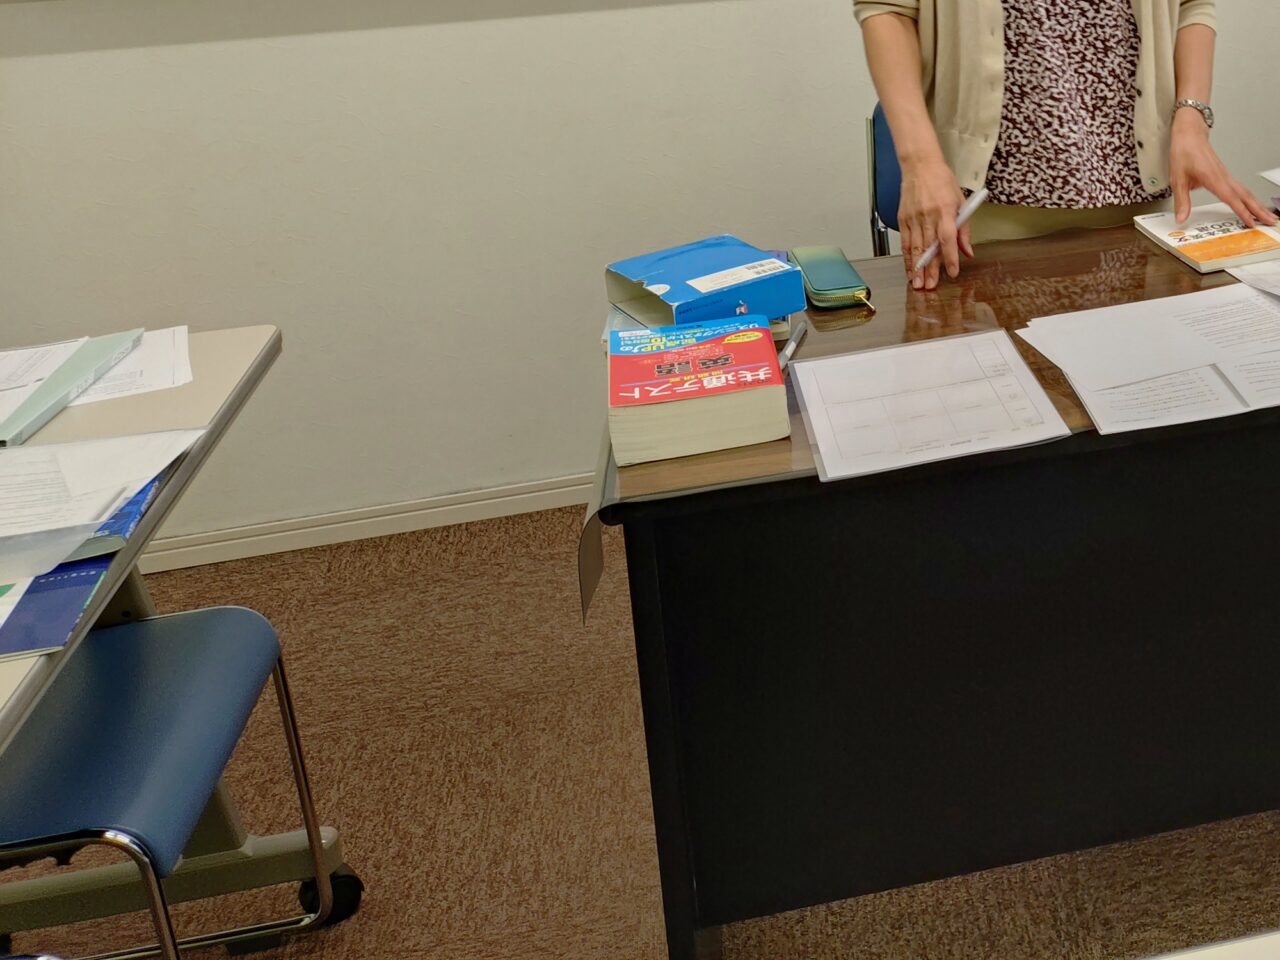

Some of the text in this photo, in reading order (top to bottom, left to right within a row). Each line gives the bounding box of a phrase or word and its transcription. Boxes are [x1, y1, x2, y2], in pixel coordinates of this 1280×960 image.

[654, 354, 734, 377] 英語
[618, 366, 773, 400] 共通テスト
